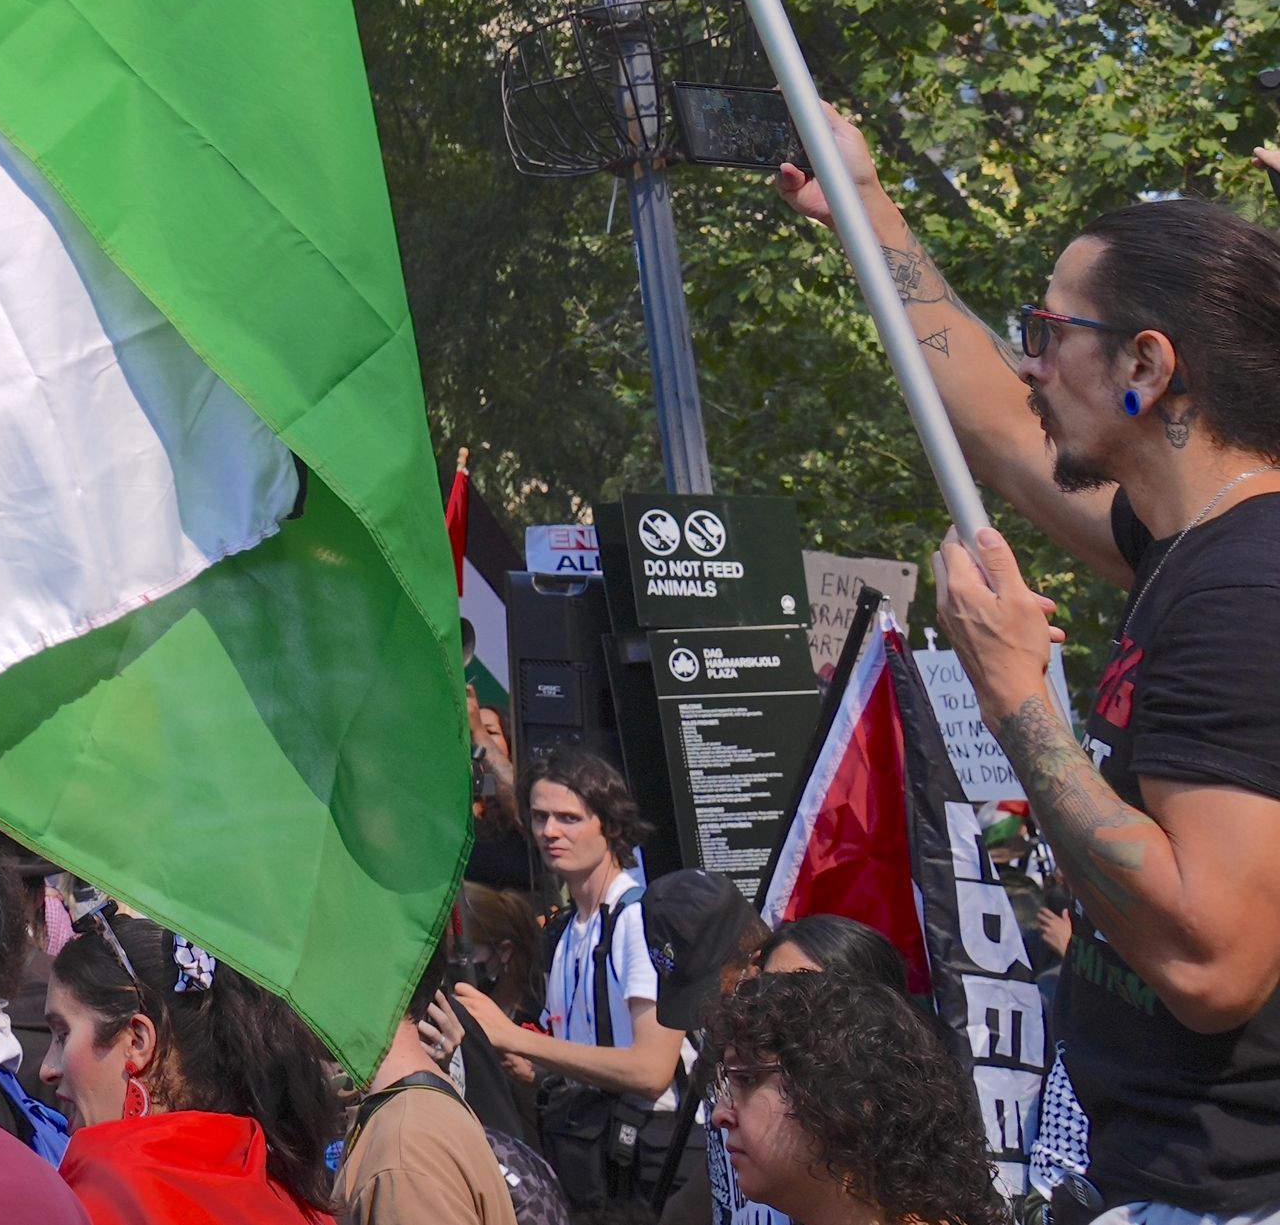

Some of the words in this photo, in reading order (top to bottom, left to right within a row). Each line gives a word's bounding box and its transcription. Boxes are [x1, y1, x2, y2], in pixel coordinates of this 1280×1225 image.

[644, 559, 669, 577] DO
[672, 560, 700, 578] NOT
[703, 561, 744, 579] FEED
[647, 580, 717, 598] ANIMALS
[703, 647, 723, 659] DAG
[707, 667, 738, 679] PLAZA
[939, 694, 958, 710] TO
